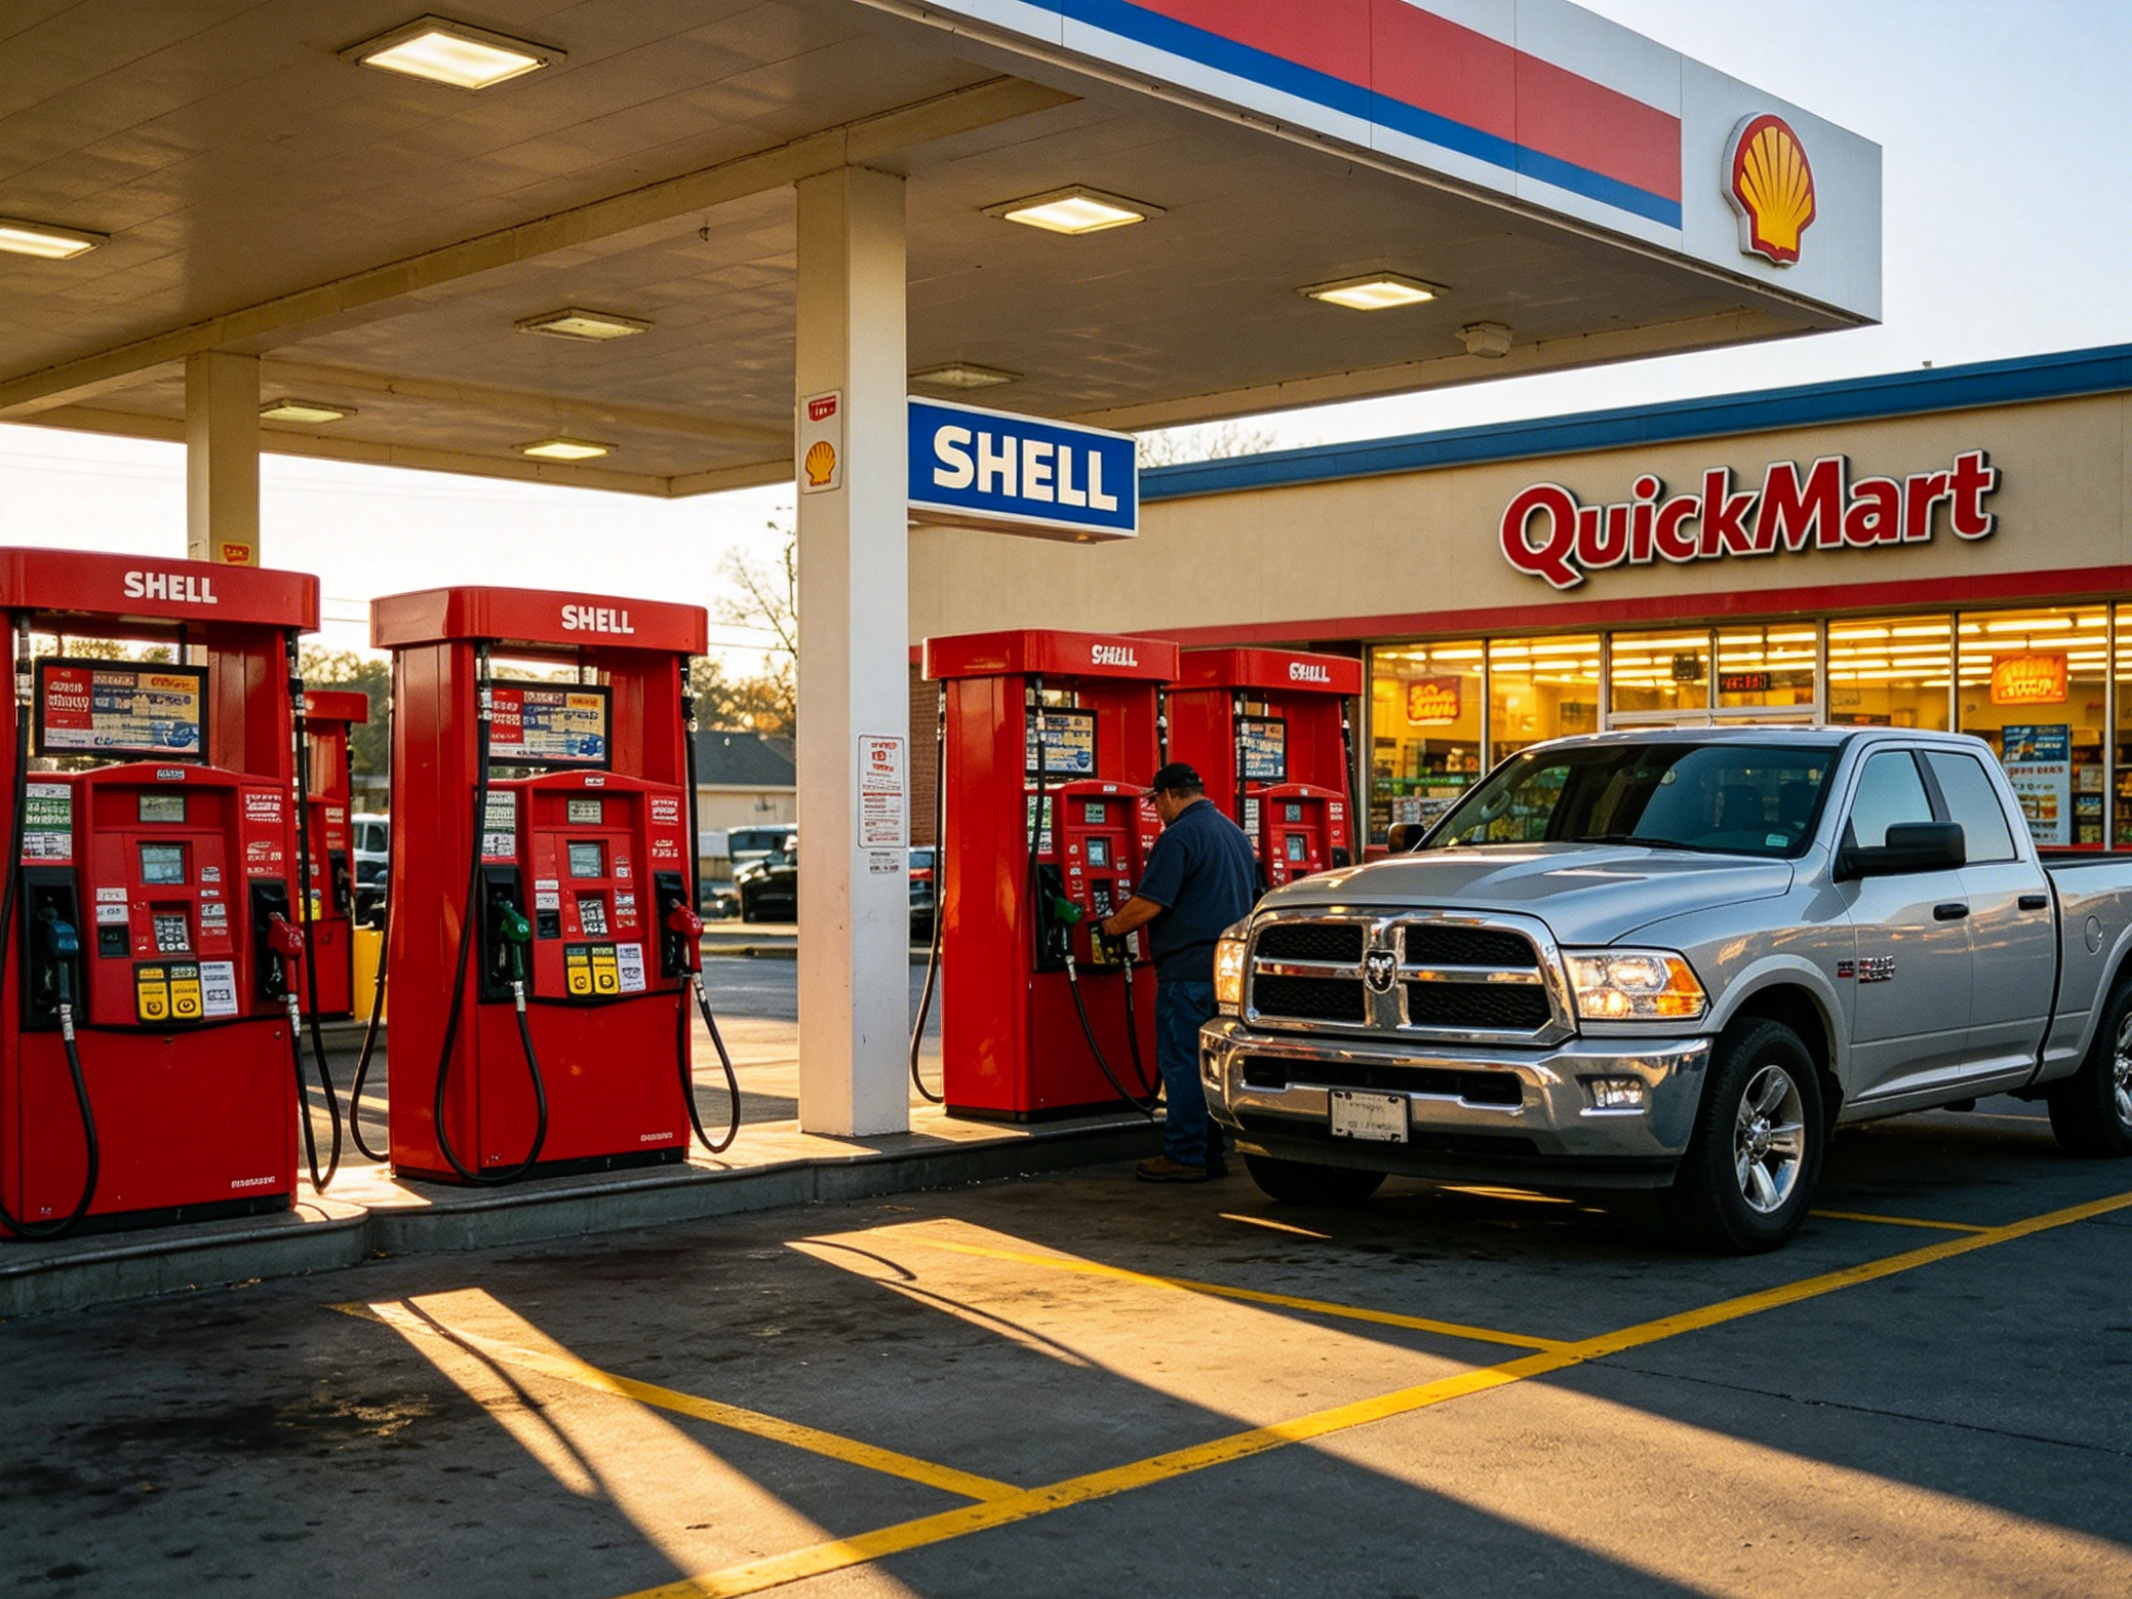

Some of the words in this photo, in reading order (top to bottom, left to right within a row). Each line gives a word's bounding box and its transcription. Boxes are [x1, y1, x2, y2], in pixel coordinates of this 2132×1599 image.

[933, 424, 1118, 512] SHELL
[1499, 449, 2000, 590] QuickMart
[123, 571, 218, 604] SHELL
[561, 604, 635, 634] SHELL
